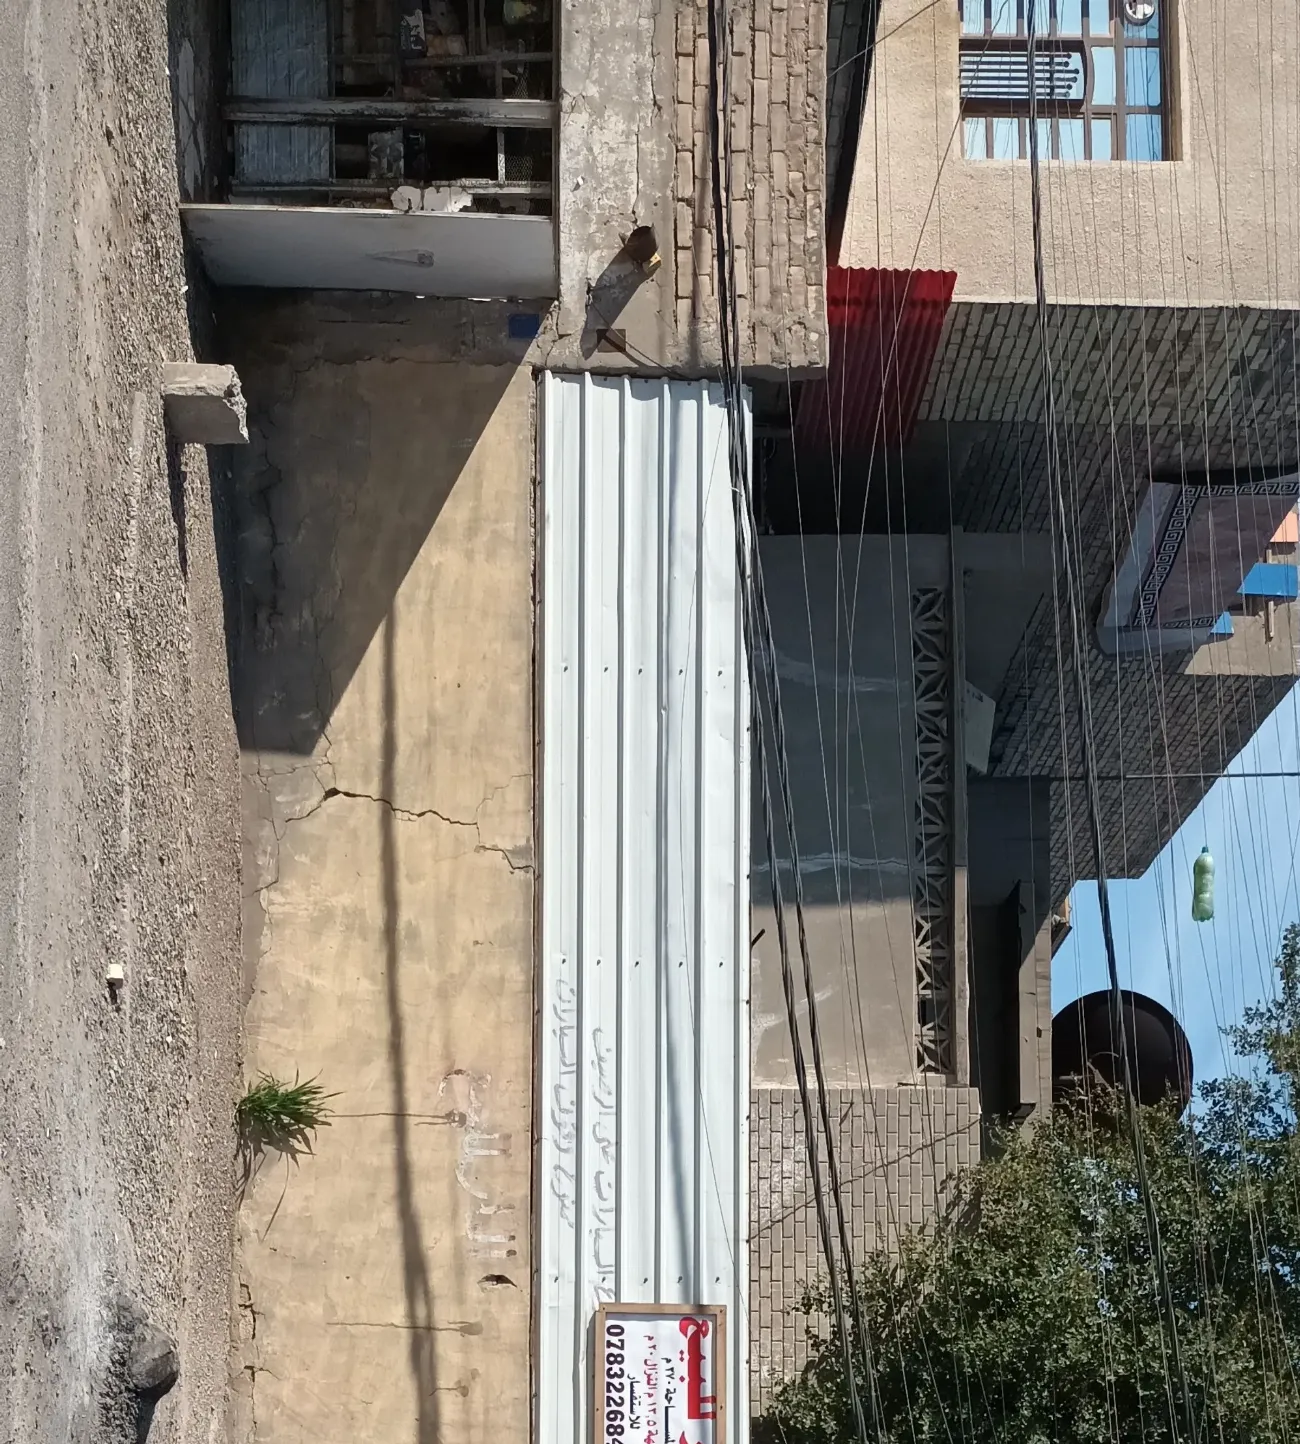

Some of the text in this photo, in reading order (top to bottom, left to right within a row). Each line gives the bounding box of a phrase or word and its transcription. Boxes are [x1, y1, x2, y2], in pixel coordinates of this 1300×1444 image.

[592, 1122, 616, 1165] على
[644, 1358, 658, 1390] النزال
[679, 1316, 716, 1420] للبيع
[627, 1373, 641, 1430] للاستفسار
